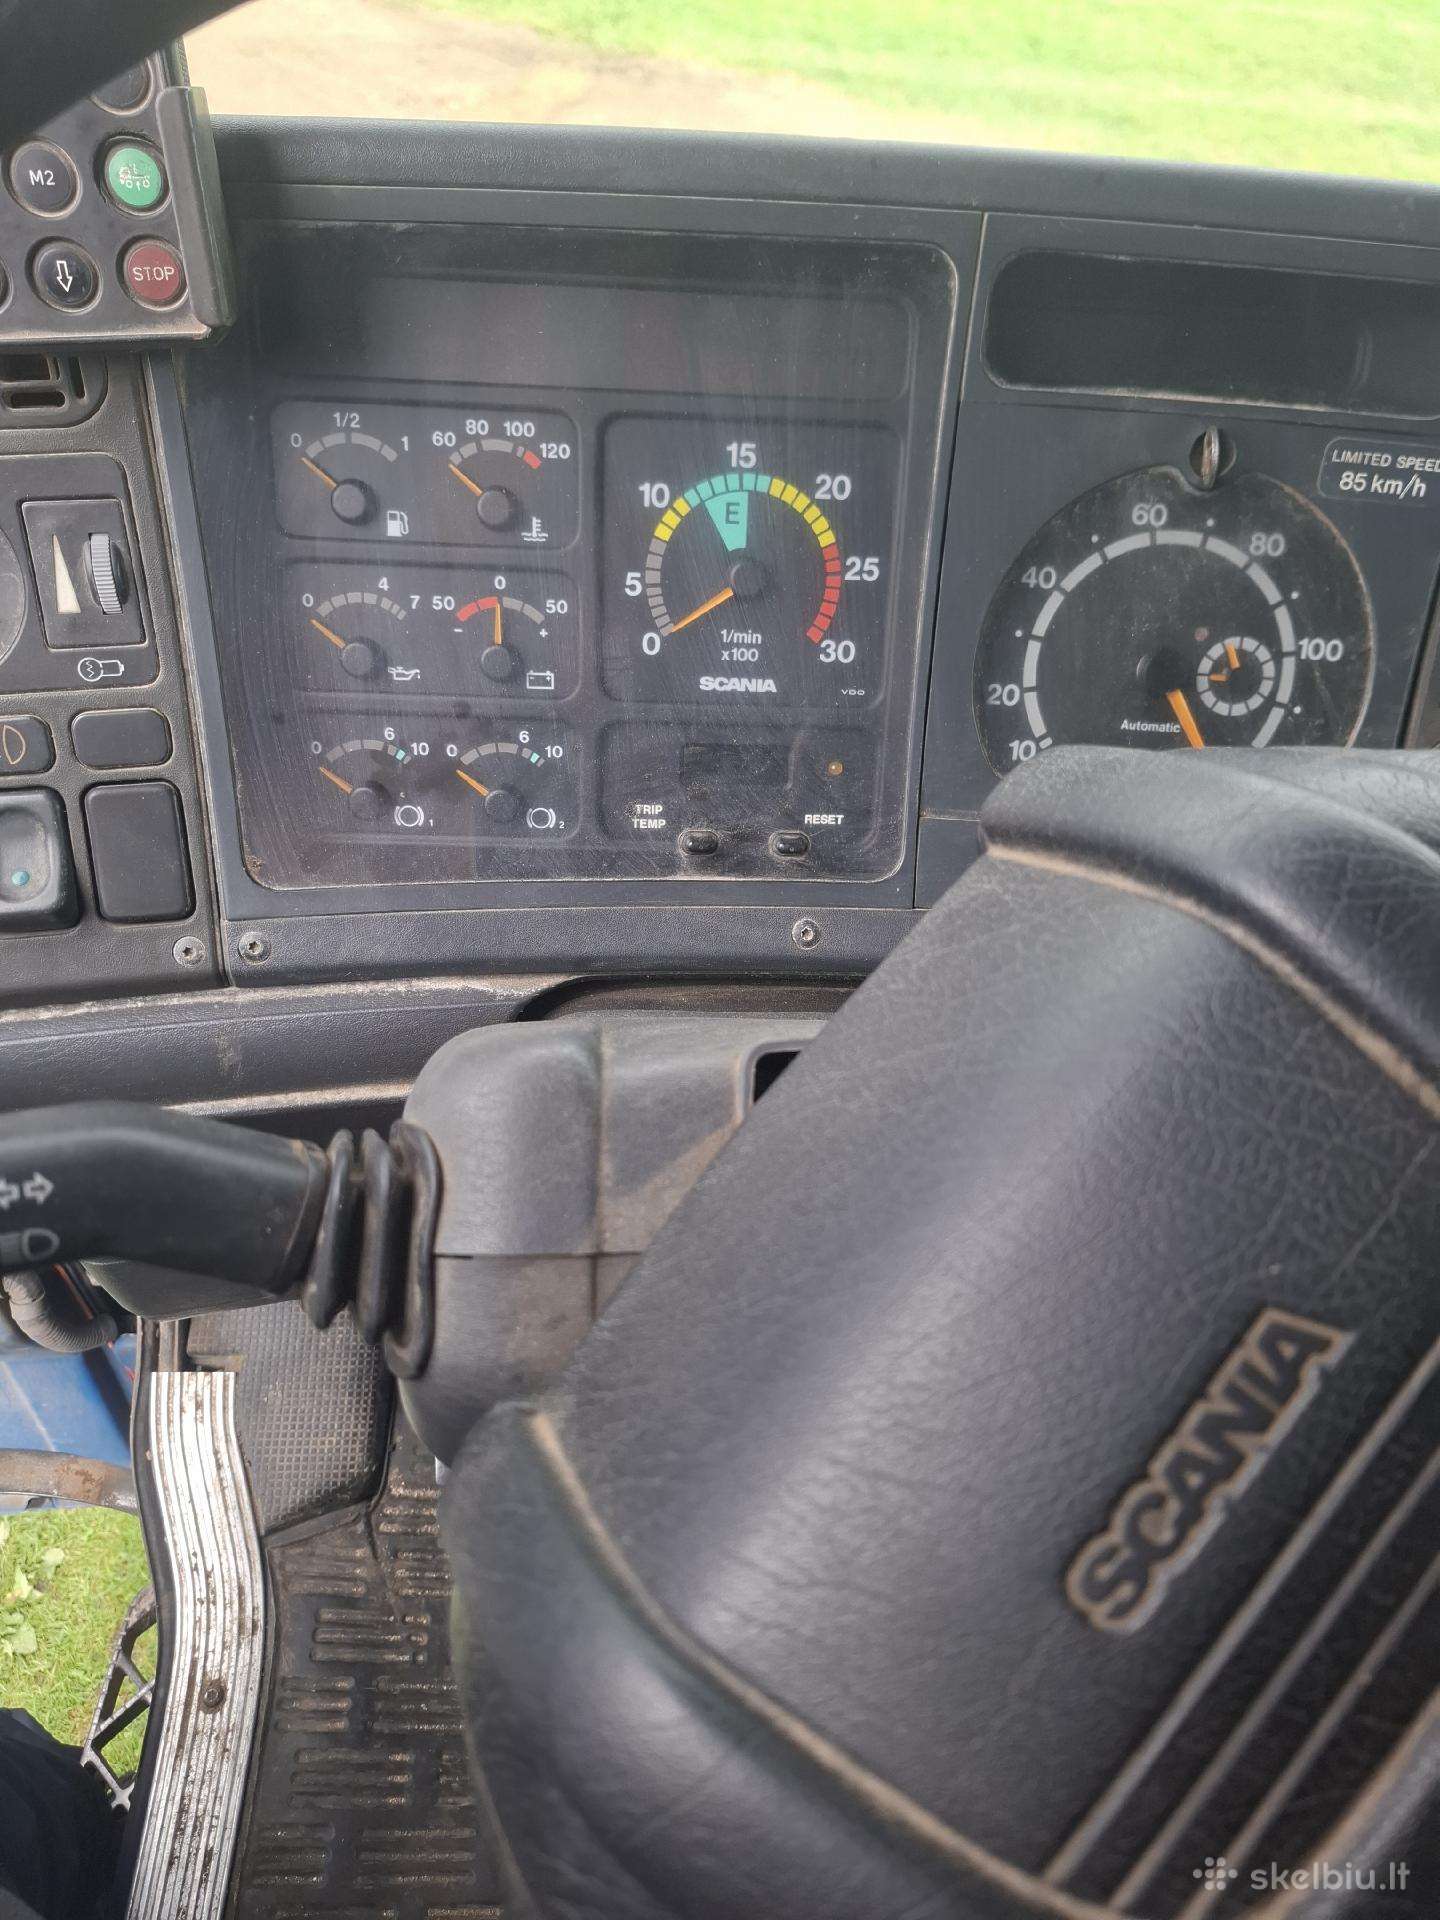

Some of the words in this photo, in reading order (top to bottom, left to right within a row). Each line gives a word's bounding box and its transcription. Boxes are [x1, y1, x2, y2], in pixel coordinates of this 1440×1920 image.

[29, 169, 56, 186] M2
[132, 267, 175, 281] STOP
[332, 412, 360, 428] 1/2
[465, 420, 489, 435] 80
[503, 422, 535, 438] 100
[290, 433, 302, 448] 0
[400, 436, 409, 451] 1
[432, 432, 457, 447] 60
[539, 443, 571, 459] 120
[726, 442, 757, 468] 15
[1331, 449, 1392, 467] LIMITED
[815, 474, 851, 501] 20
[1340, 470, 1368, 492] 85
[1370, 472, 1427, 499] km/h
[638, 483, 670, 508] 10
[725, 502, 740, 525] E
[1131, 503, 1168, 527] 60
[1248, 533, 1285, 557] 80
[844, 557, 880, 581] 25
[377, 577, 390, 591] 4
[494, 576, 506, 590] 0
[624, 572, 642, 596] 5
[1021, 566, 1057, 589] 40
[302, 593, 314, 607] 0
[410, 595, 421, 609] 7
[432, 596, 455, 610] 50
[545, 600, 568, 614] 50
[642, 632, 661, 655] 0
[720, 629, 762, 645] 1/min
[720, 648, 759, 662] x100
[819, 639, 856, 664] 30
[1299, 638, 1344, 662] 100
[699, 676, 777, 693] SCANIA
[987, 683, 1021, 707] 20
[384, 727, 395, 740] 6
[1120, 719, 1182, 733] Automatic
[518, 730, 530, 744] 6
[311, 741, 322, 755] 0
[411, 742, 430, 756] 10
[446, 744, 458, 758] 0
[545, 745, 564, 759] 10
[1008, 739, 1037, 762] 10
[635, 804, 663, 815] TRIP
[559, 820, 566, 829] 2
[632, 818, 667, 829] TEMP
[804, 814, 845, 826] RESET
[1065, 1306, 1357, 1636] SCANIA
